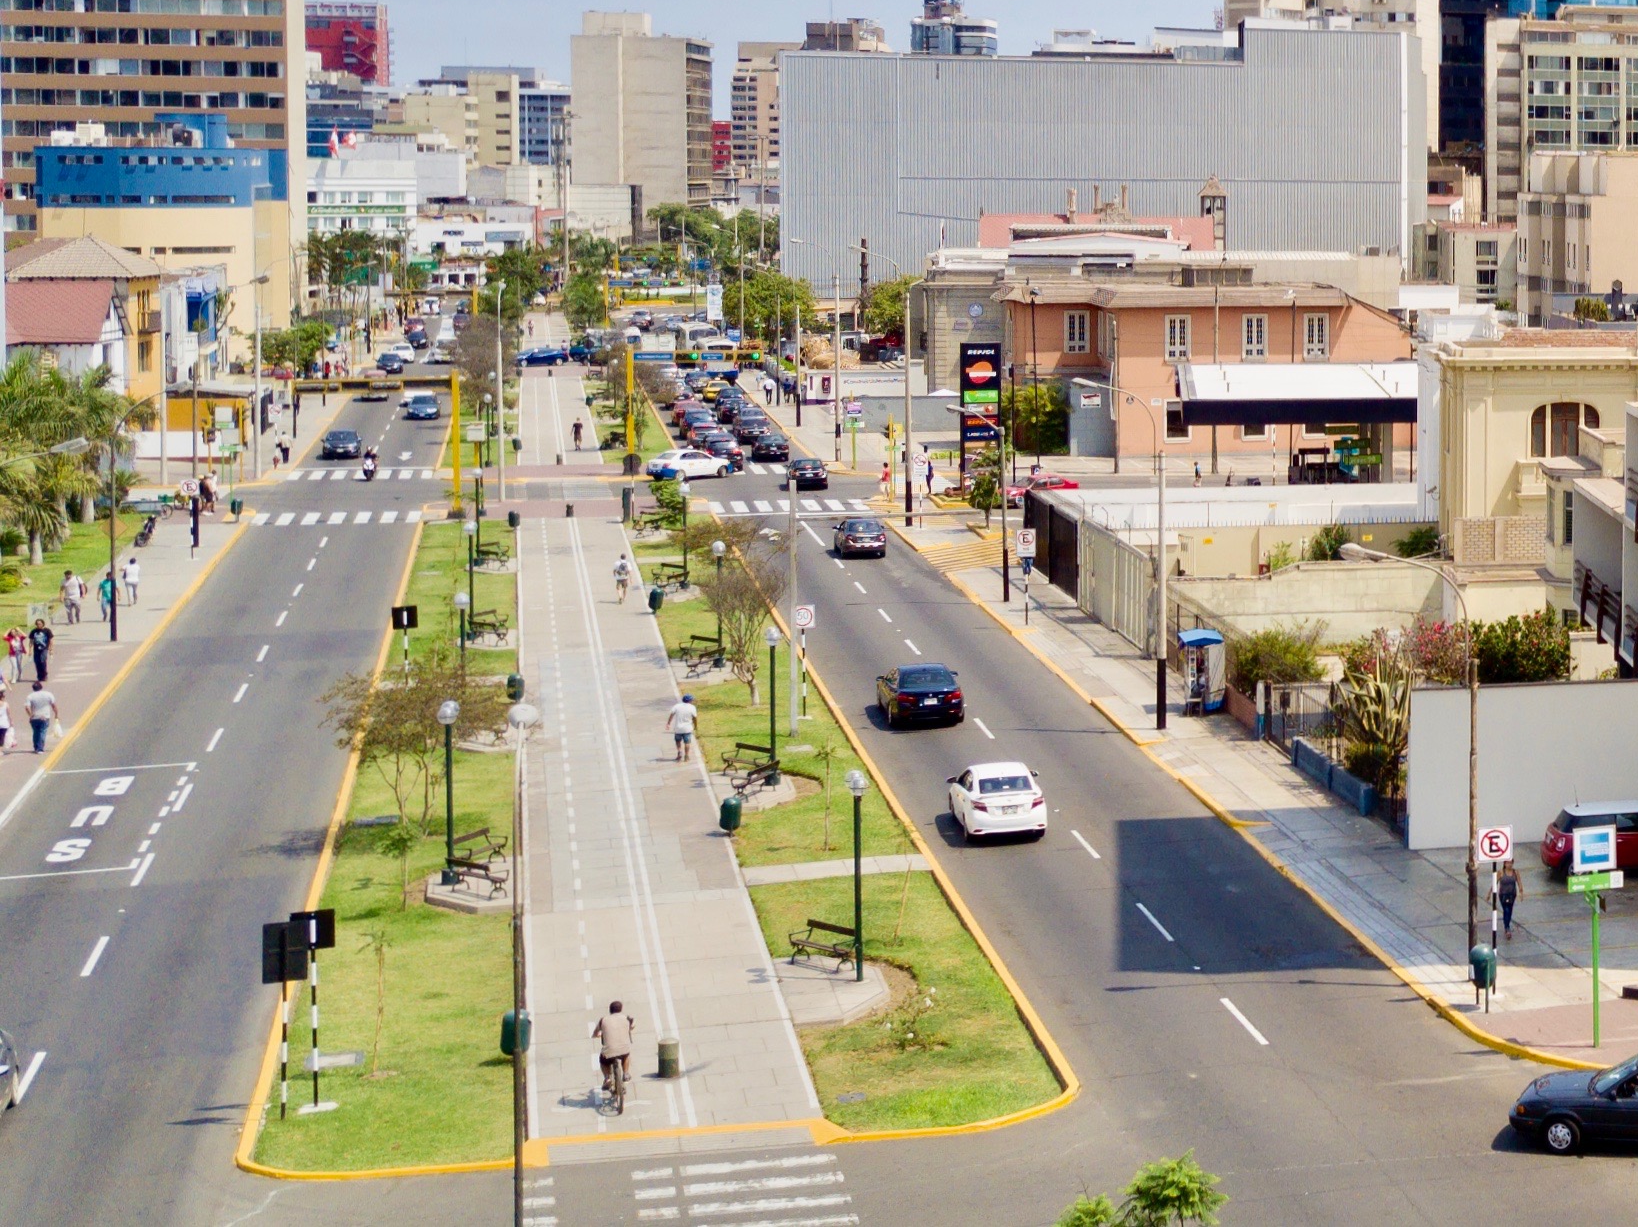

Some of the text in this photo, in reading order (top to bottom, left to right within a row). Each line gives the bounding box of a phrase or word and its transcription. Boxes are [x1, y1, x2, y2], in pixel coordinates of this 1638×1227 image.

[1022, 533, 1031, 544] E
[797, 611, 809, 621] 50
[45, 775, 135, 862] BUS
[1489, 835, 1501, 854] E
